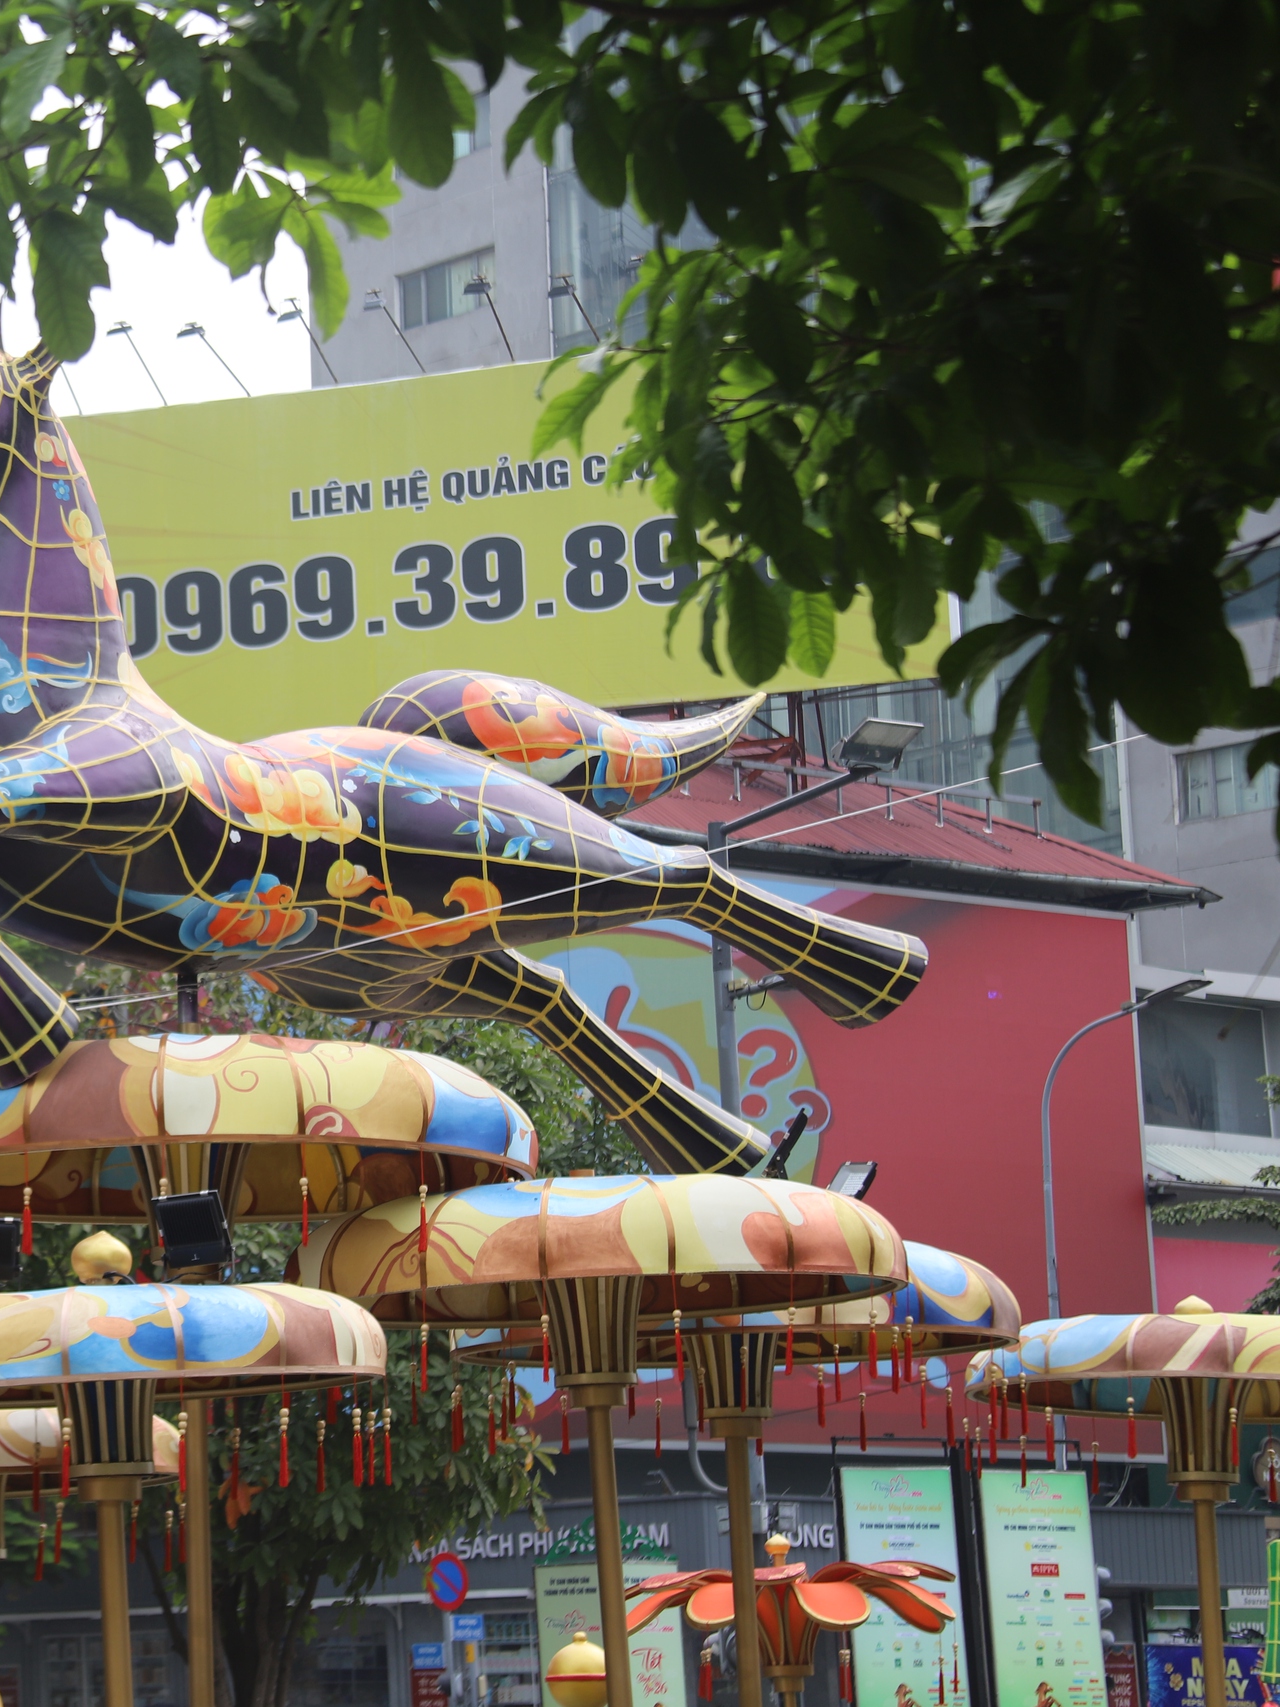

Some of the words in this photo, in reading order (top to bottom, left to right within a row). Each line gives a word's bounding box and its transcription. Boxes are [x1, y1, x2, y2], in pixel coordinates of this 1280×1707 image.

[291, 480, 372, 520] LIÊN
[383, 470, 429, 512] HỆ
[442, 456, 570, 505] QUẢNG
[455, 1529, 513, 1560] SÁCH
[1191, 1657, 1243, 1678] MA
[1186, 1677, 1250, 1699] NAY
